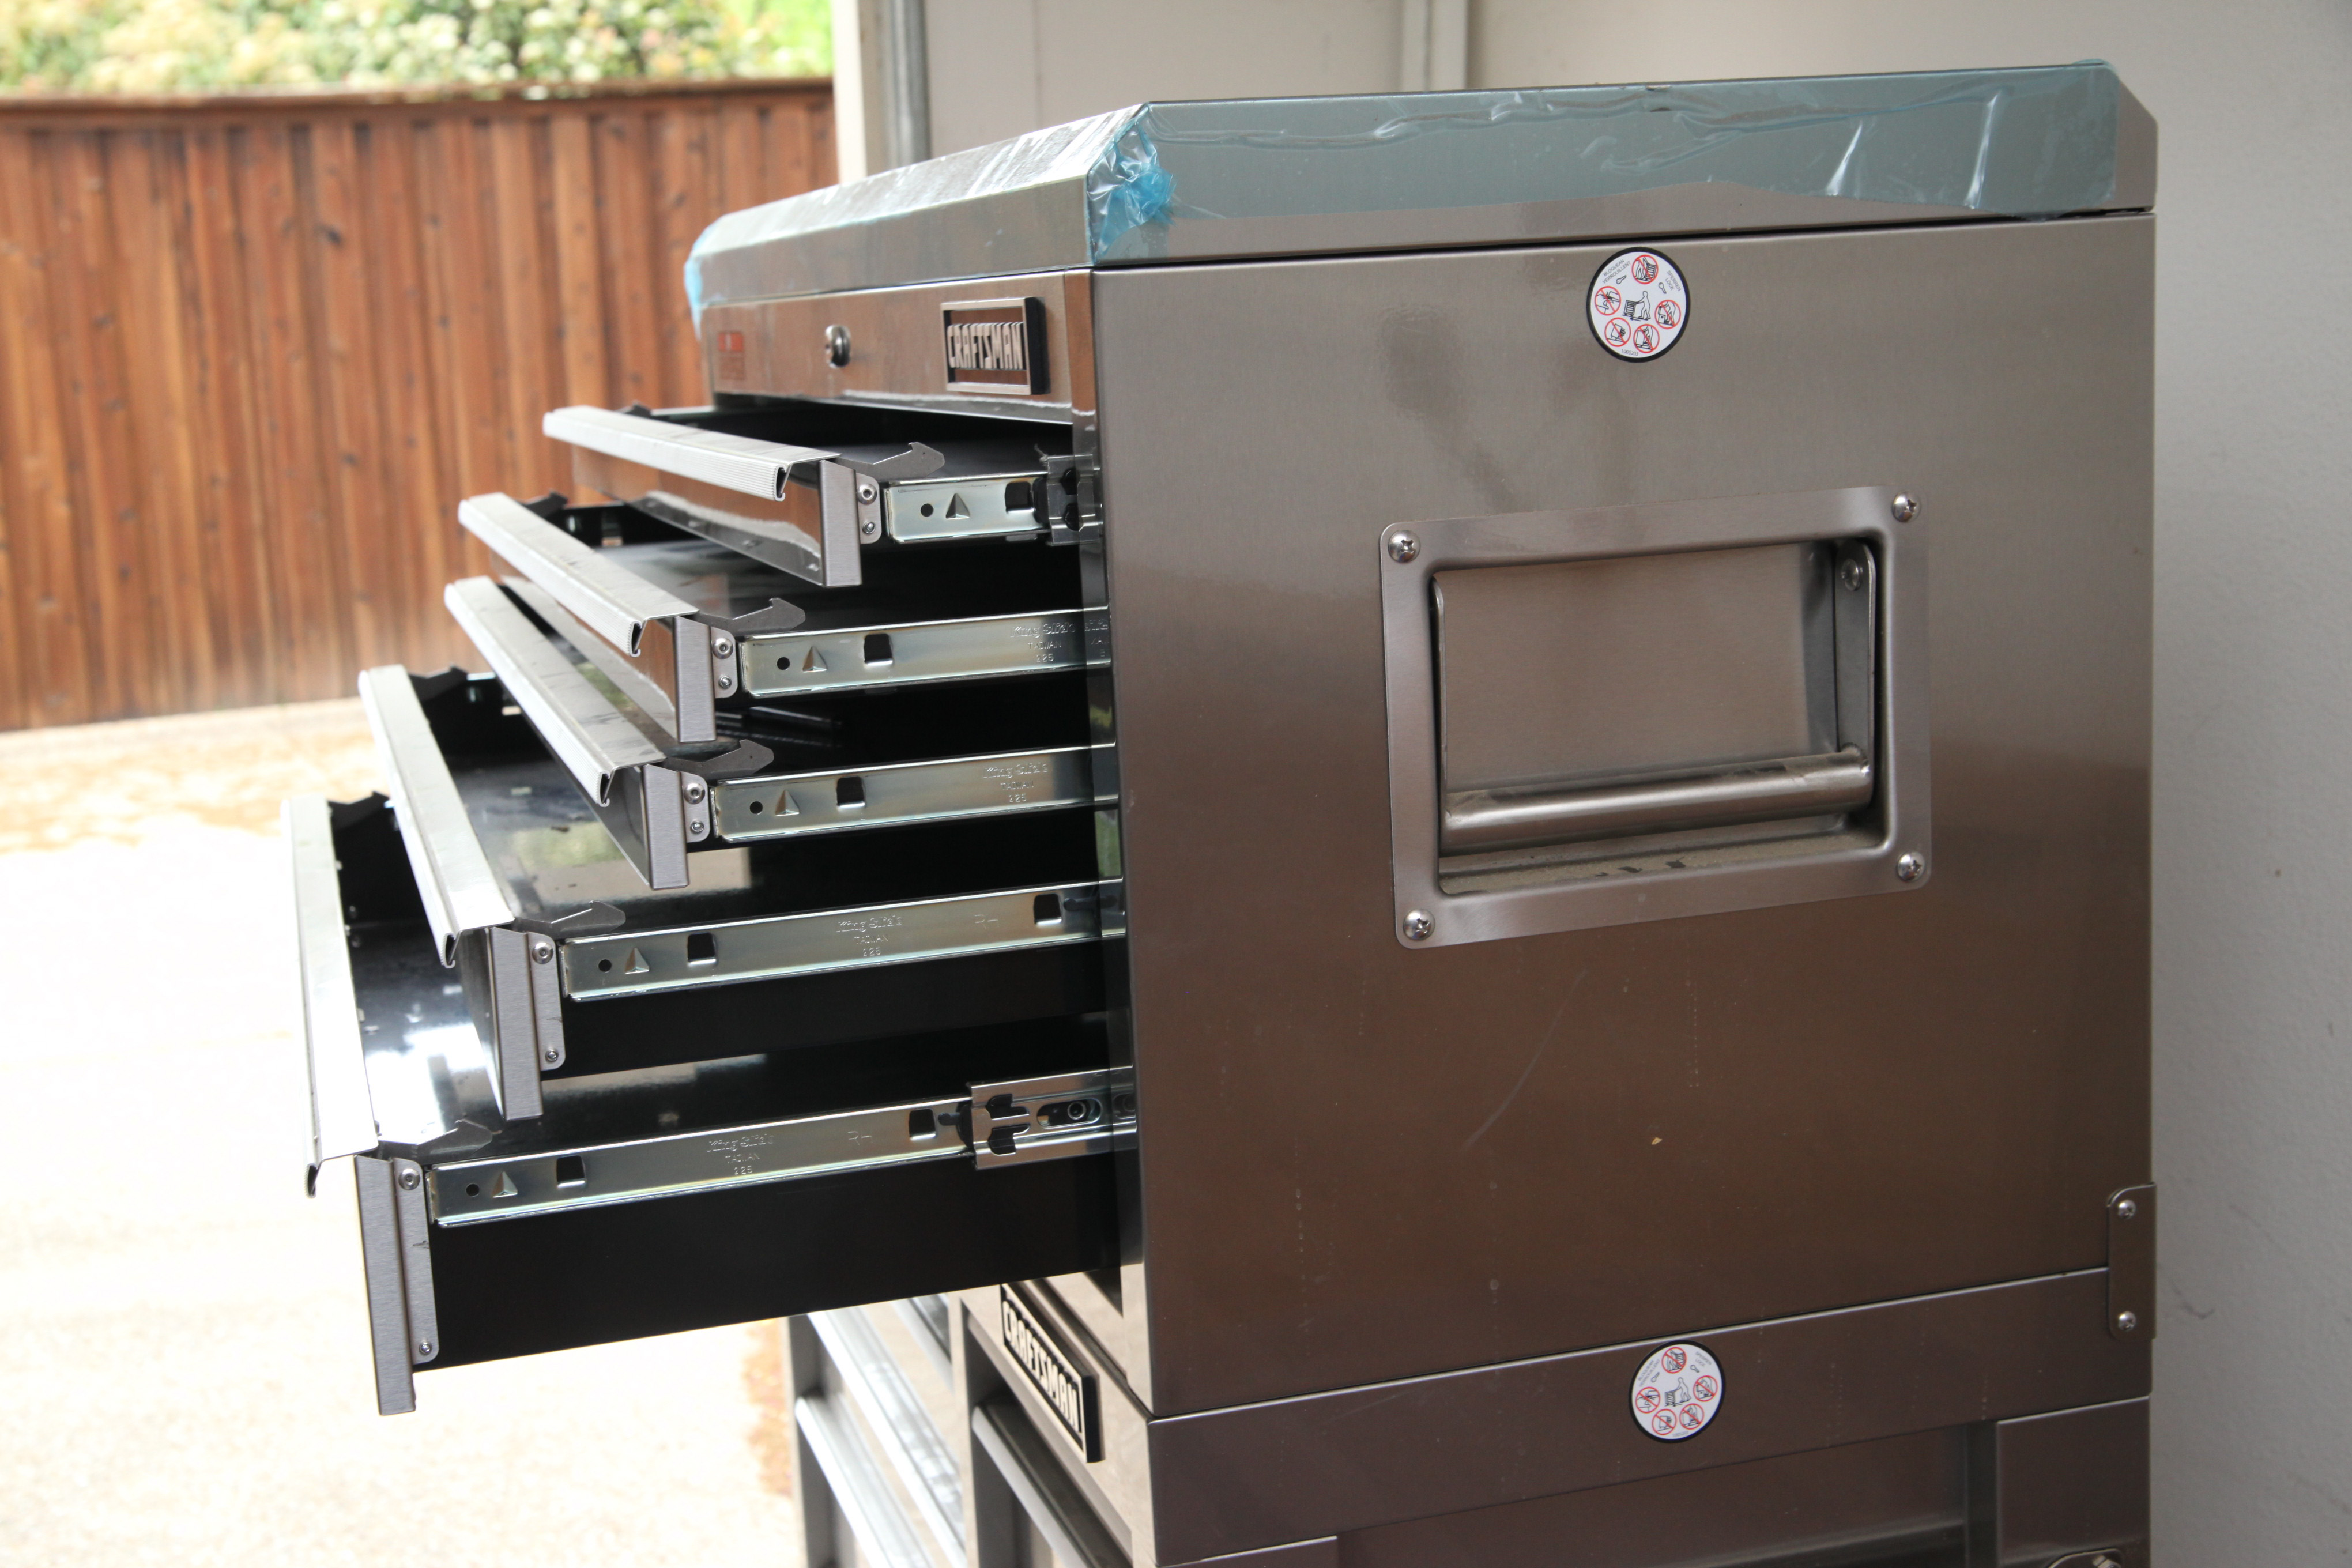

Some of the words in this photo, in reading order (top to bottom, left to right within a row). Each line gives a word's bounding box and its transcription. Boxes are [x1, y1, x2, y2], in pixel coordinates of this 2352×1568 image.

[1601, 260, 1631, 284] VERROUILLENT
[1603, 258, 1625, 277] BLOQUEAN
[1665, 278, 1675, 291] LOCK
[1667, 270, 1682, 292] SPERREN
[947, 322, 1024, 370] CRAFTSMAN
[1621, 348, 1639, 357] 1005203
[1027, 640, 1062, 650] TAIWAN
[1035, 653, 1054, 663] 225
[1000, 780, 1035, 791] TAIWAN
[1008, 794, 1028, 803] 225
[853, 933, 889, 945] TAIWAN
[862, 947, 881, 957] 225
[733, 1165, 753, 1175] 225
[1002, 1299, 1080, 1433] CRAFTSMAN
